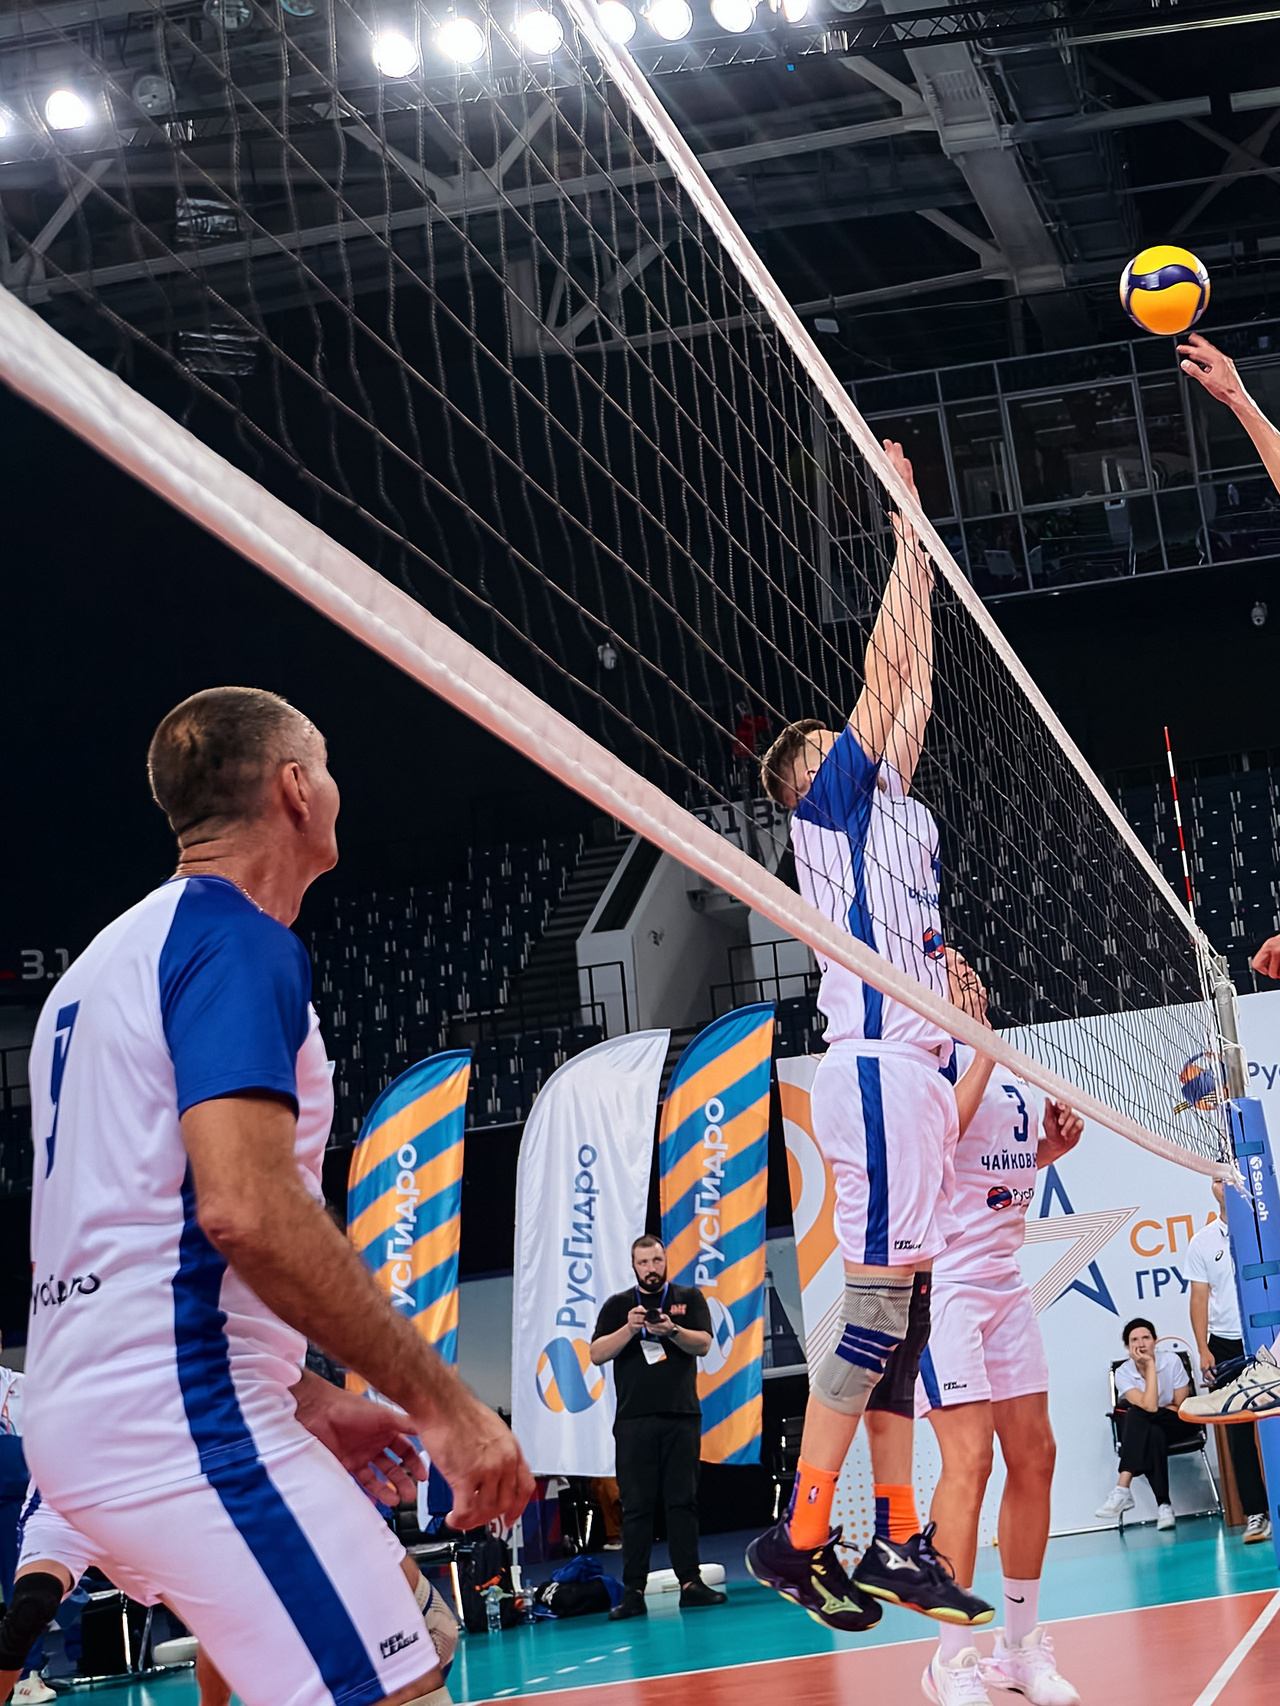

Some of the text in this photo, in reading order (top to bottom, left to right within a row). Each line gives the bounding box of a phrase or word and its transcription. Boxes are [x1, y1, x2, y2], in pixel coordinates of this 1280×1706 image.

[694, 1097, 730, 1288] РусГидро
[1001, 1084, 1029, 1142] 3
[386, 1143, 421, 1308] усГидро
[556, 1143, 600, 1329] РусГидро
